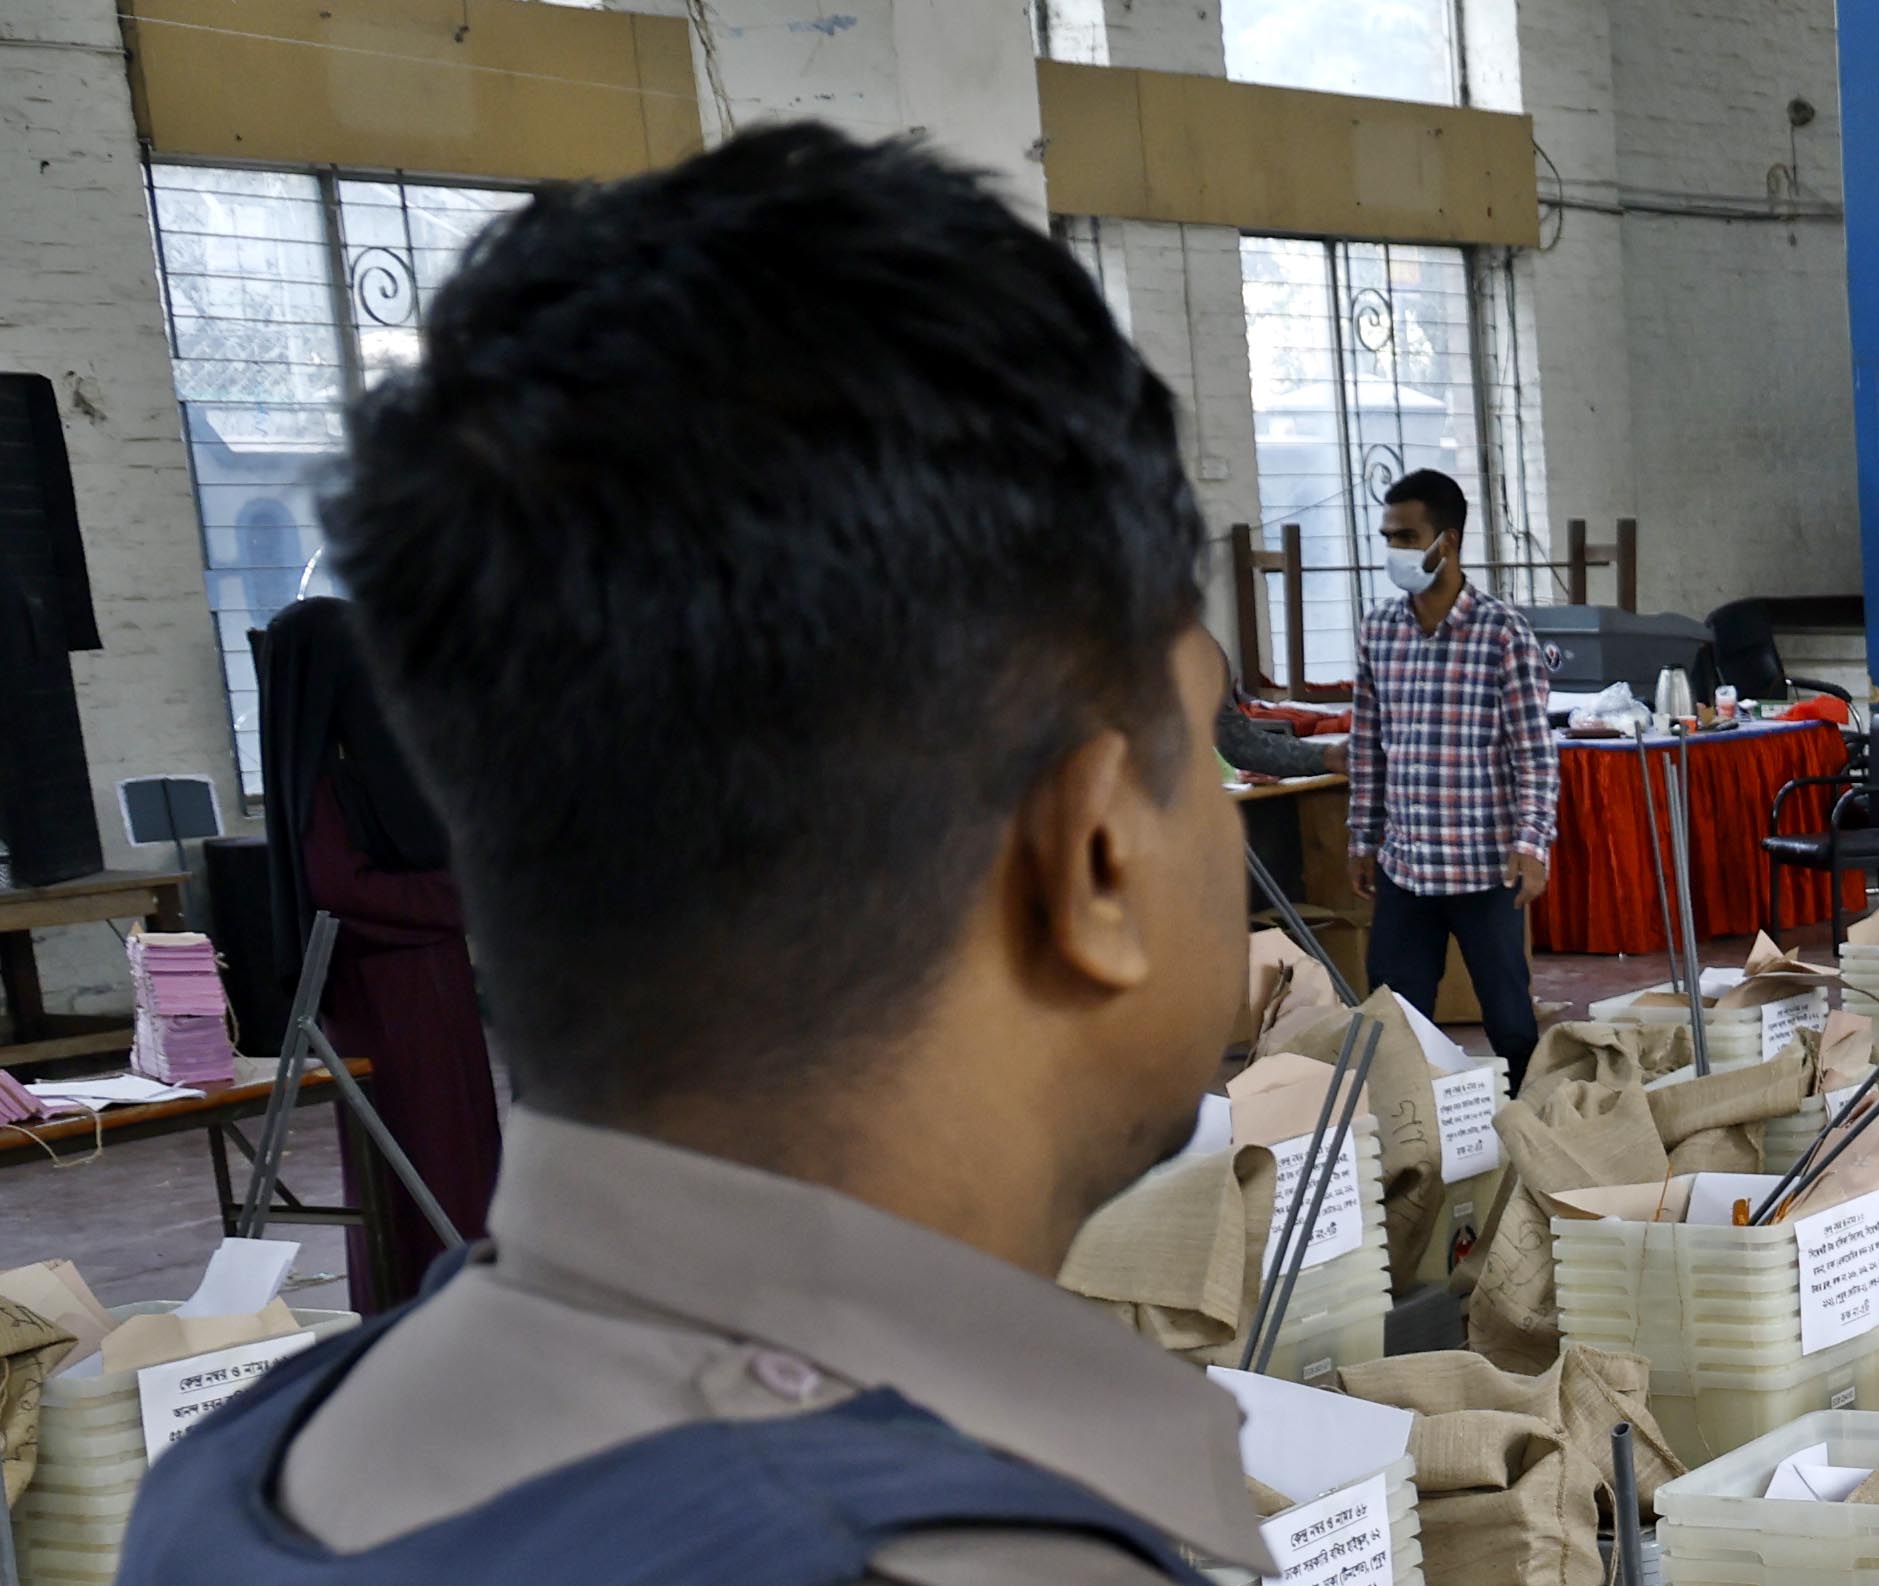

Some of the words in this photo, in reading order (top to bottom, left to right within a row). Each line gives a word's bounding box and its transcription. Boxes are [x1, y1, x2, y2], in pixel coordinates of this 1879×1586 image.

[231, 1366, 240, 1378] ও
[1290, 1528, 1308, 1548] কেন্দ্র
[1309, 1521, 1326, 1537] নম্বর
[1326, 1516, 1334, 1529] ও
